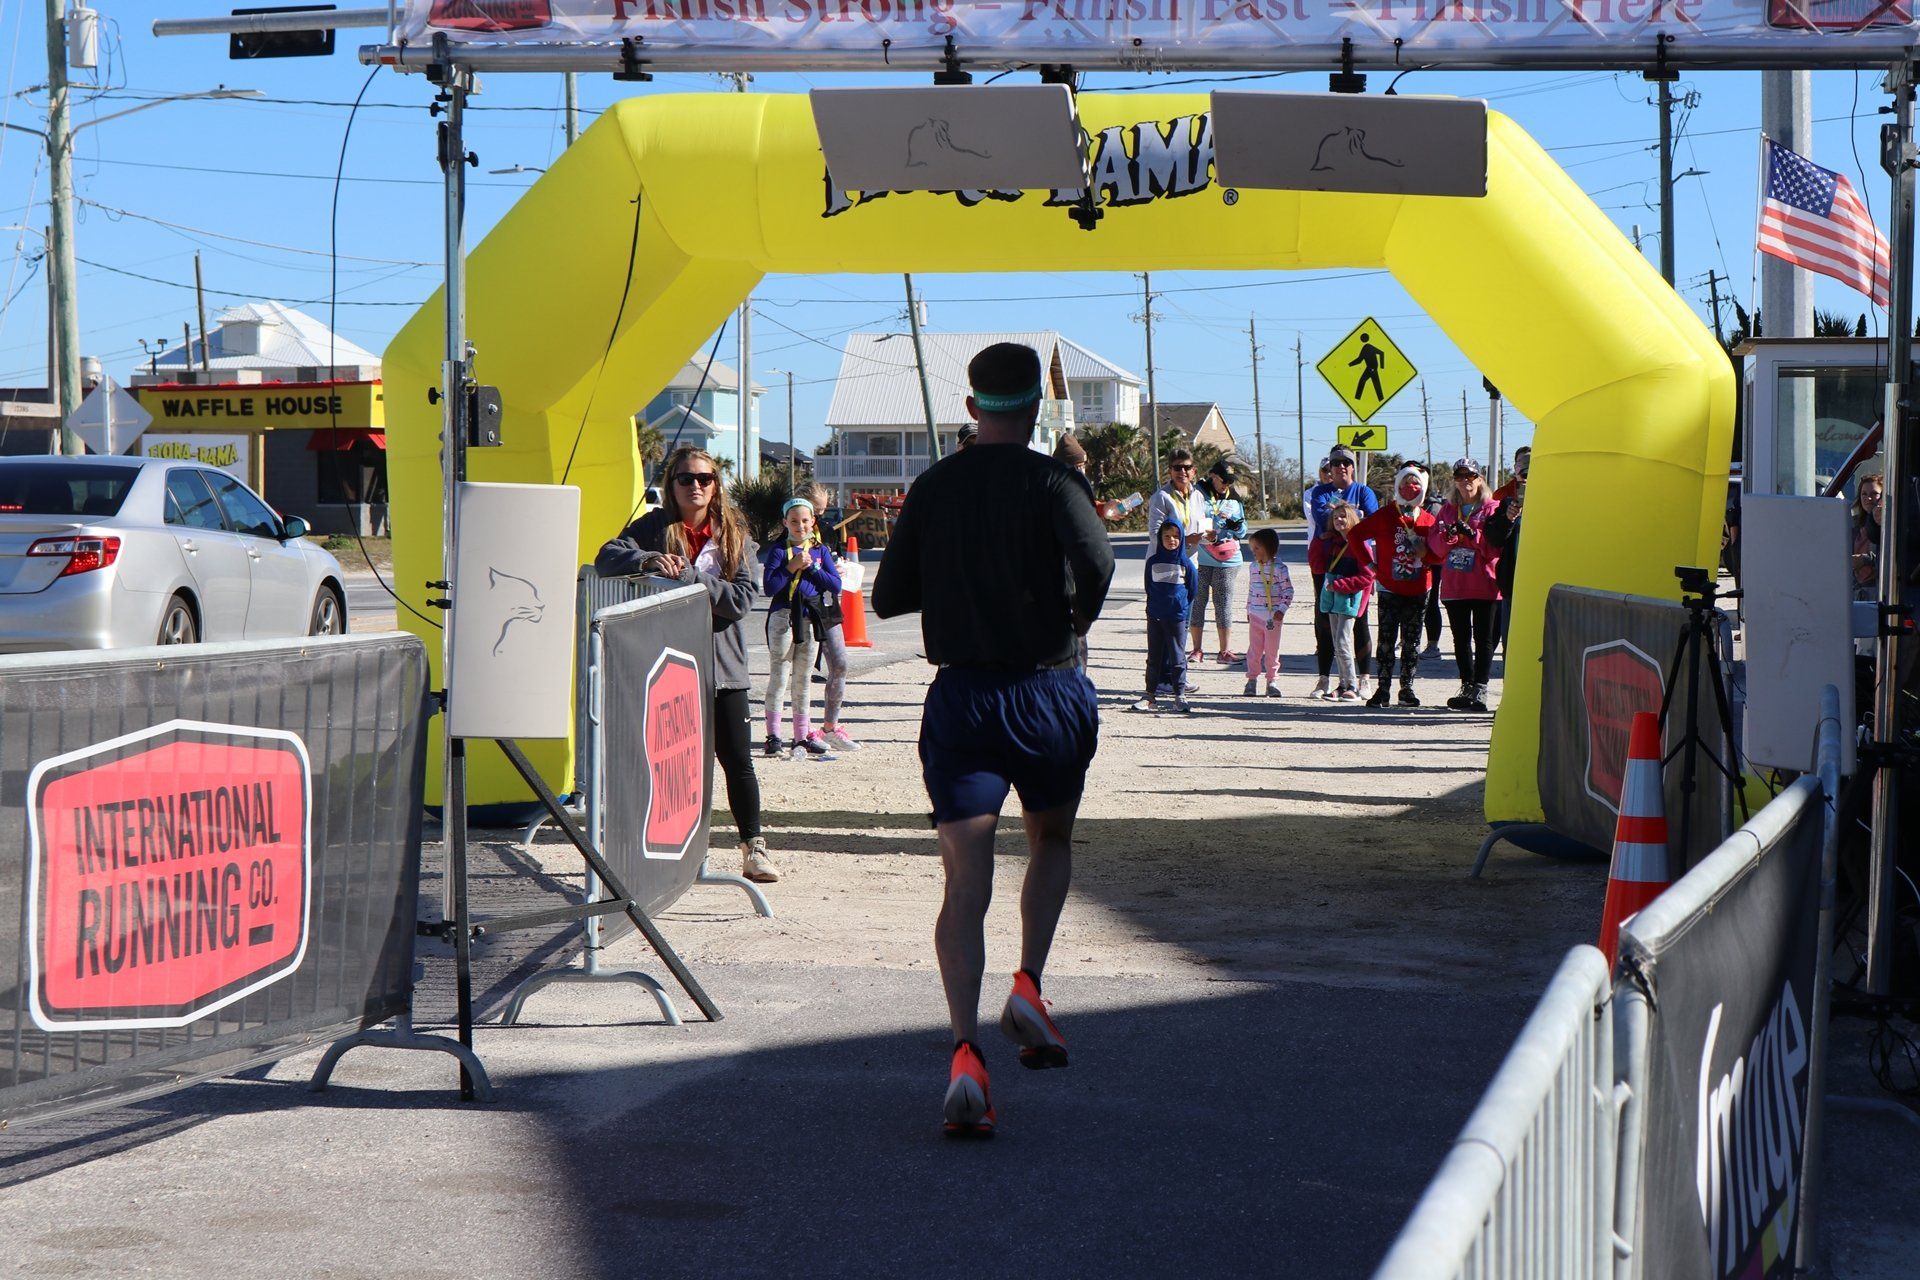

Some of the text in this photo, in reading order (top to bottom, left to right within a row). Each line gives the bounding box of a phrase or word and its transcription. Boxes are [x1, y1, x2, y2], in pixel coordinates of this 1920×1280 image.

[612, 0, 768, 21] Finish
[784, 0, 957, 35] Strong
[1018, 0, 1182, 21] Finish
[1200, 0, 1310, 21] Fast
[1375, 0, 1548, 23] Finish
[1563, 0, 1702, 23] Here
[162, 396, 342, 417] WAFFLE HOUSE
[654, 690, 698, 753] INTERNATIONAL
[74, 781, 281, 876] INTERNATIONAL
[76, 858, 279, 979] RUNNING CO.
